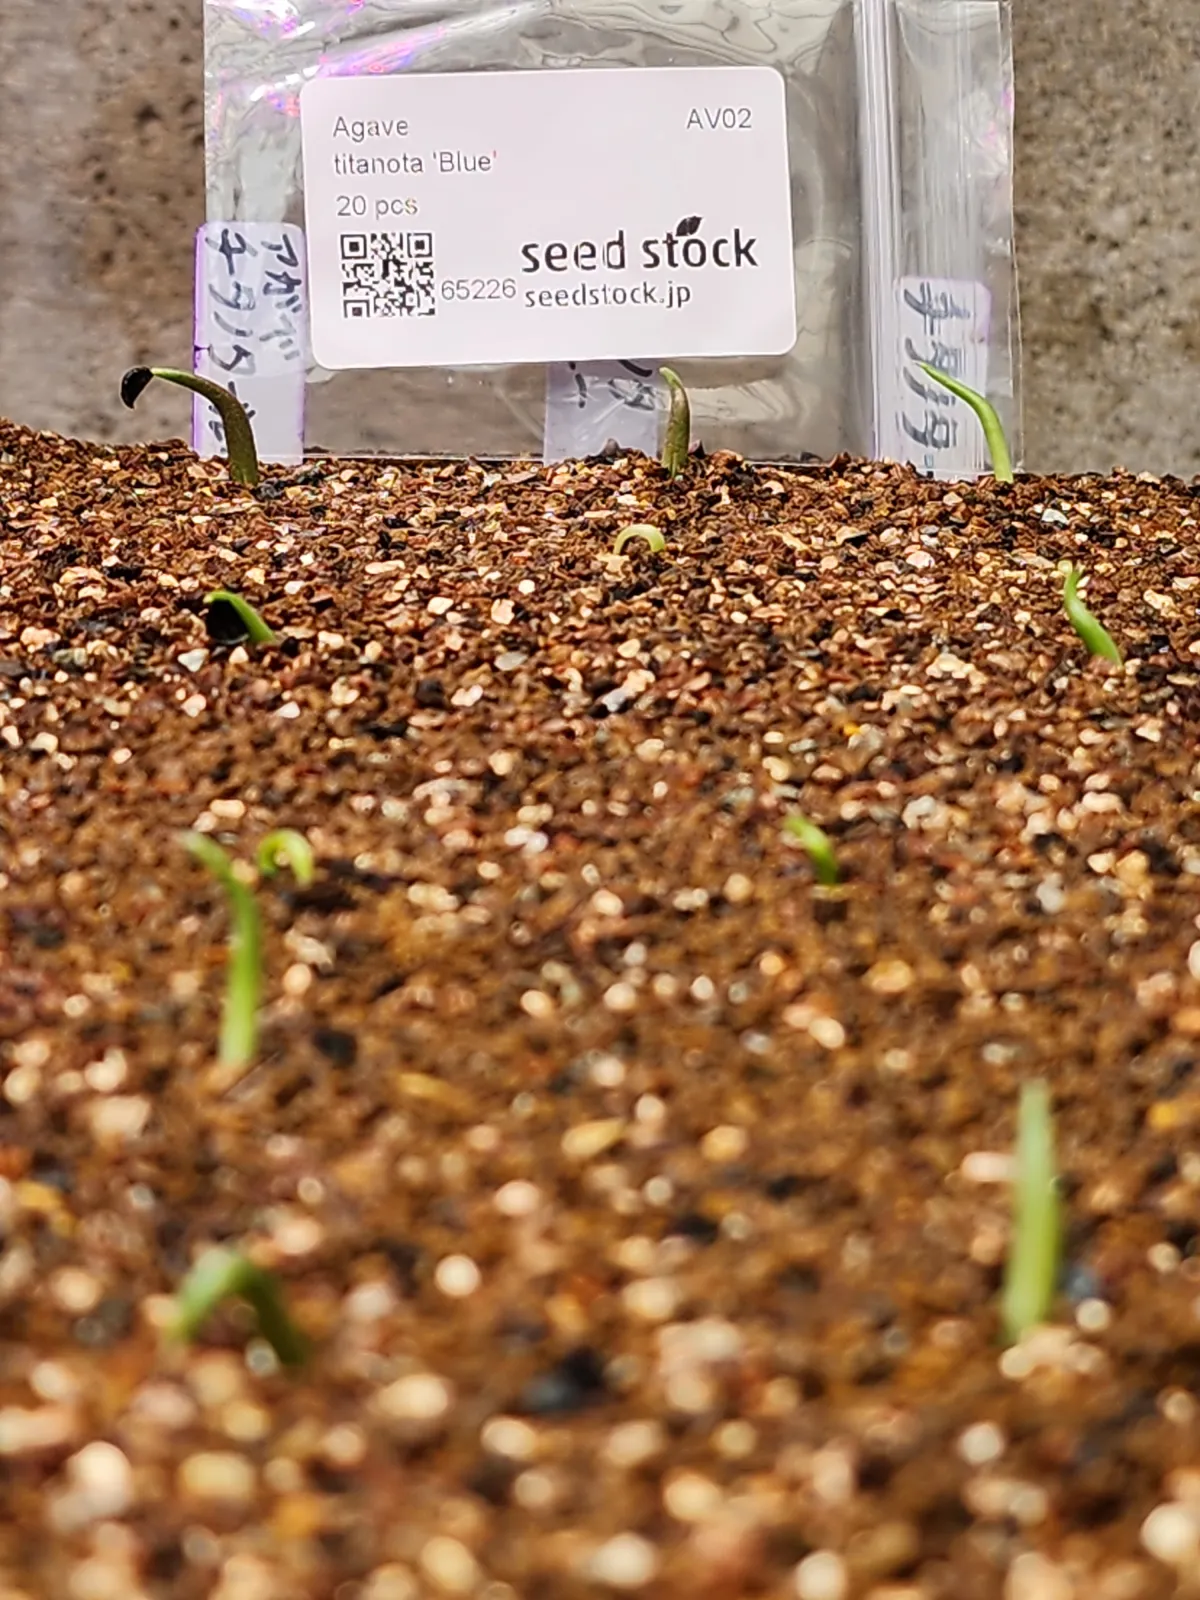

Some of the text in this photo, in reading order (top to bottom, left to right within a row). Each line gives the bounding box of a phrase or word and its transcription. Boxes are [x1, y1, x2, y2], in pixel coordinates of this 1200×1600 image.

[333, 116, 409, 138] Agave
[687, 108, 752, 129] AV02
[334, 150, 497, 174] titanota 'Blue'
[337, 195, 418, 220] 20 pcs
[521, 226, 759, 273] seed stock
[441, 278, 516, 300] 65226
[525, 281, 691, 308] seedstock.jp
